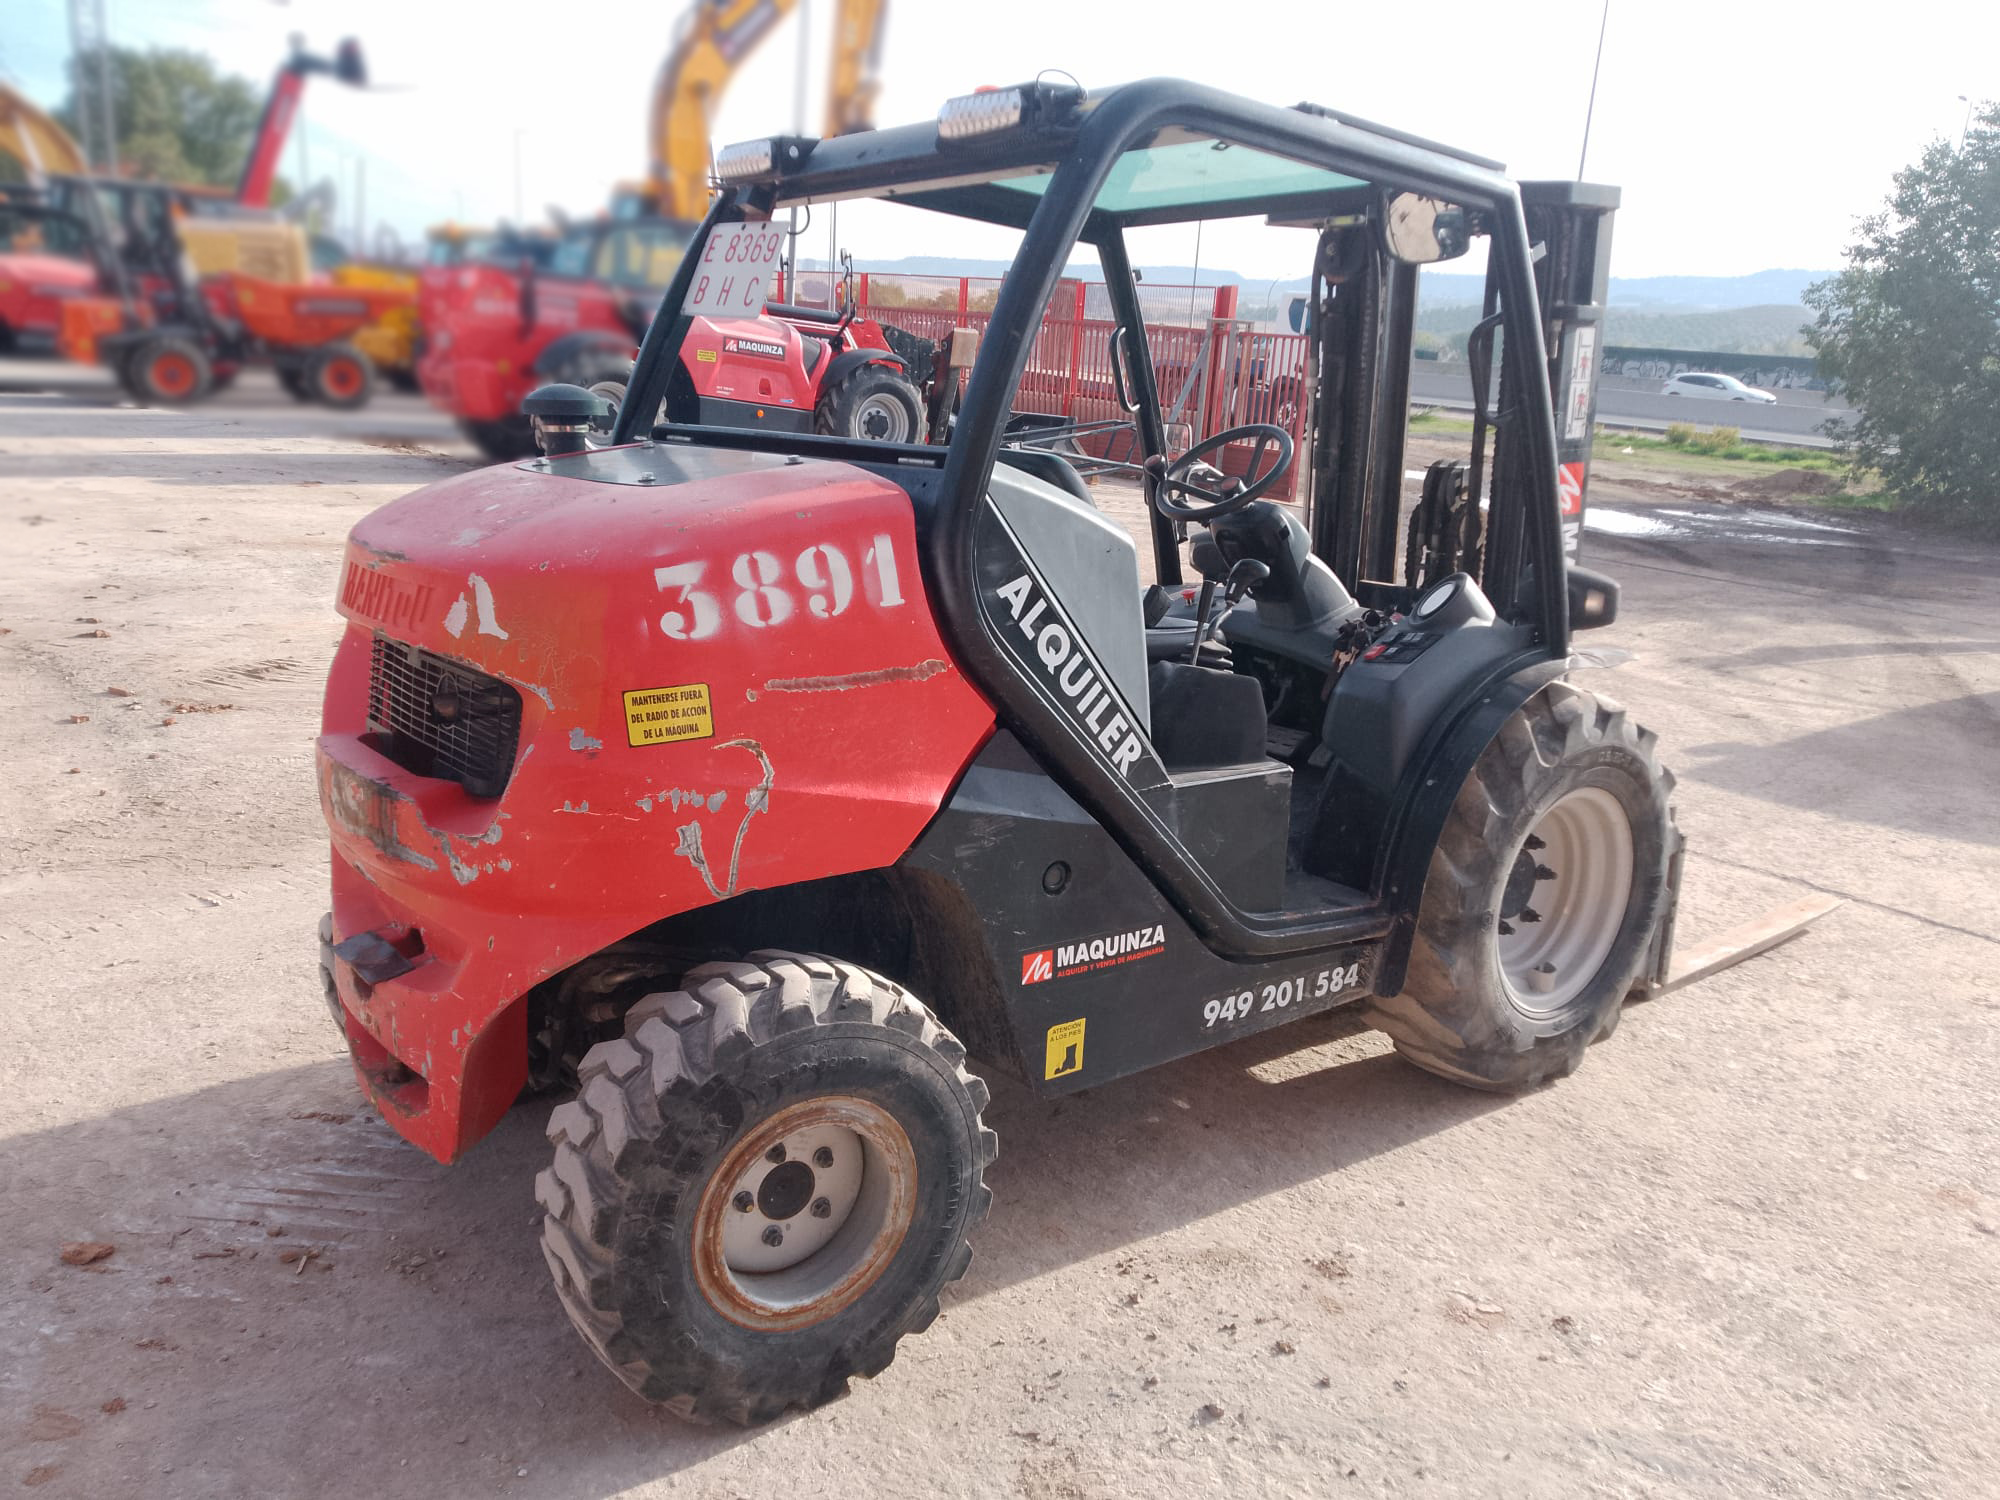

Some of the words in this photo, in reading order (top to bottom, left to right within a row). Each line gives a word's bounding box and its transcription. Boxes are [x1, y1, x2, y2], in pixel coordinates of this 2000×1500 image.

[704, 234, 722, 262] E
[724, 232, 779, 262] 8369
[738, 340, 783, 356] MAQUINZA
[654, 534, 905, 640] 3891
[996, 574, 1142, 778] ALQUILER
[631, 692, 678, 706] MANTENERSE
[680, 689, 703, 701] FUERA
[631, 713, 644, 724] DEL
[646, 710, 669, 722] RADIO
[670, 708, 680, 719] DE
[643, 728, 653, 739] DE
[655, 727, 664, 738] LA
[1057, 924, 1165, 968] MAQUINZA
[1057, 965, 1089, 978] ALQUILER
[1090, 963, 1095, 971] Y
[1096, 959, 1116, 969] VENTA
[1117, 956, 1125, 964] DE
[1126, 946, 1164, 961] MAQUINARIA
[1203, 991, 1254, 1028] 949
[1260, 977, 1305, 1013] 201
[1314, 963, 1359, 998] 584
